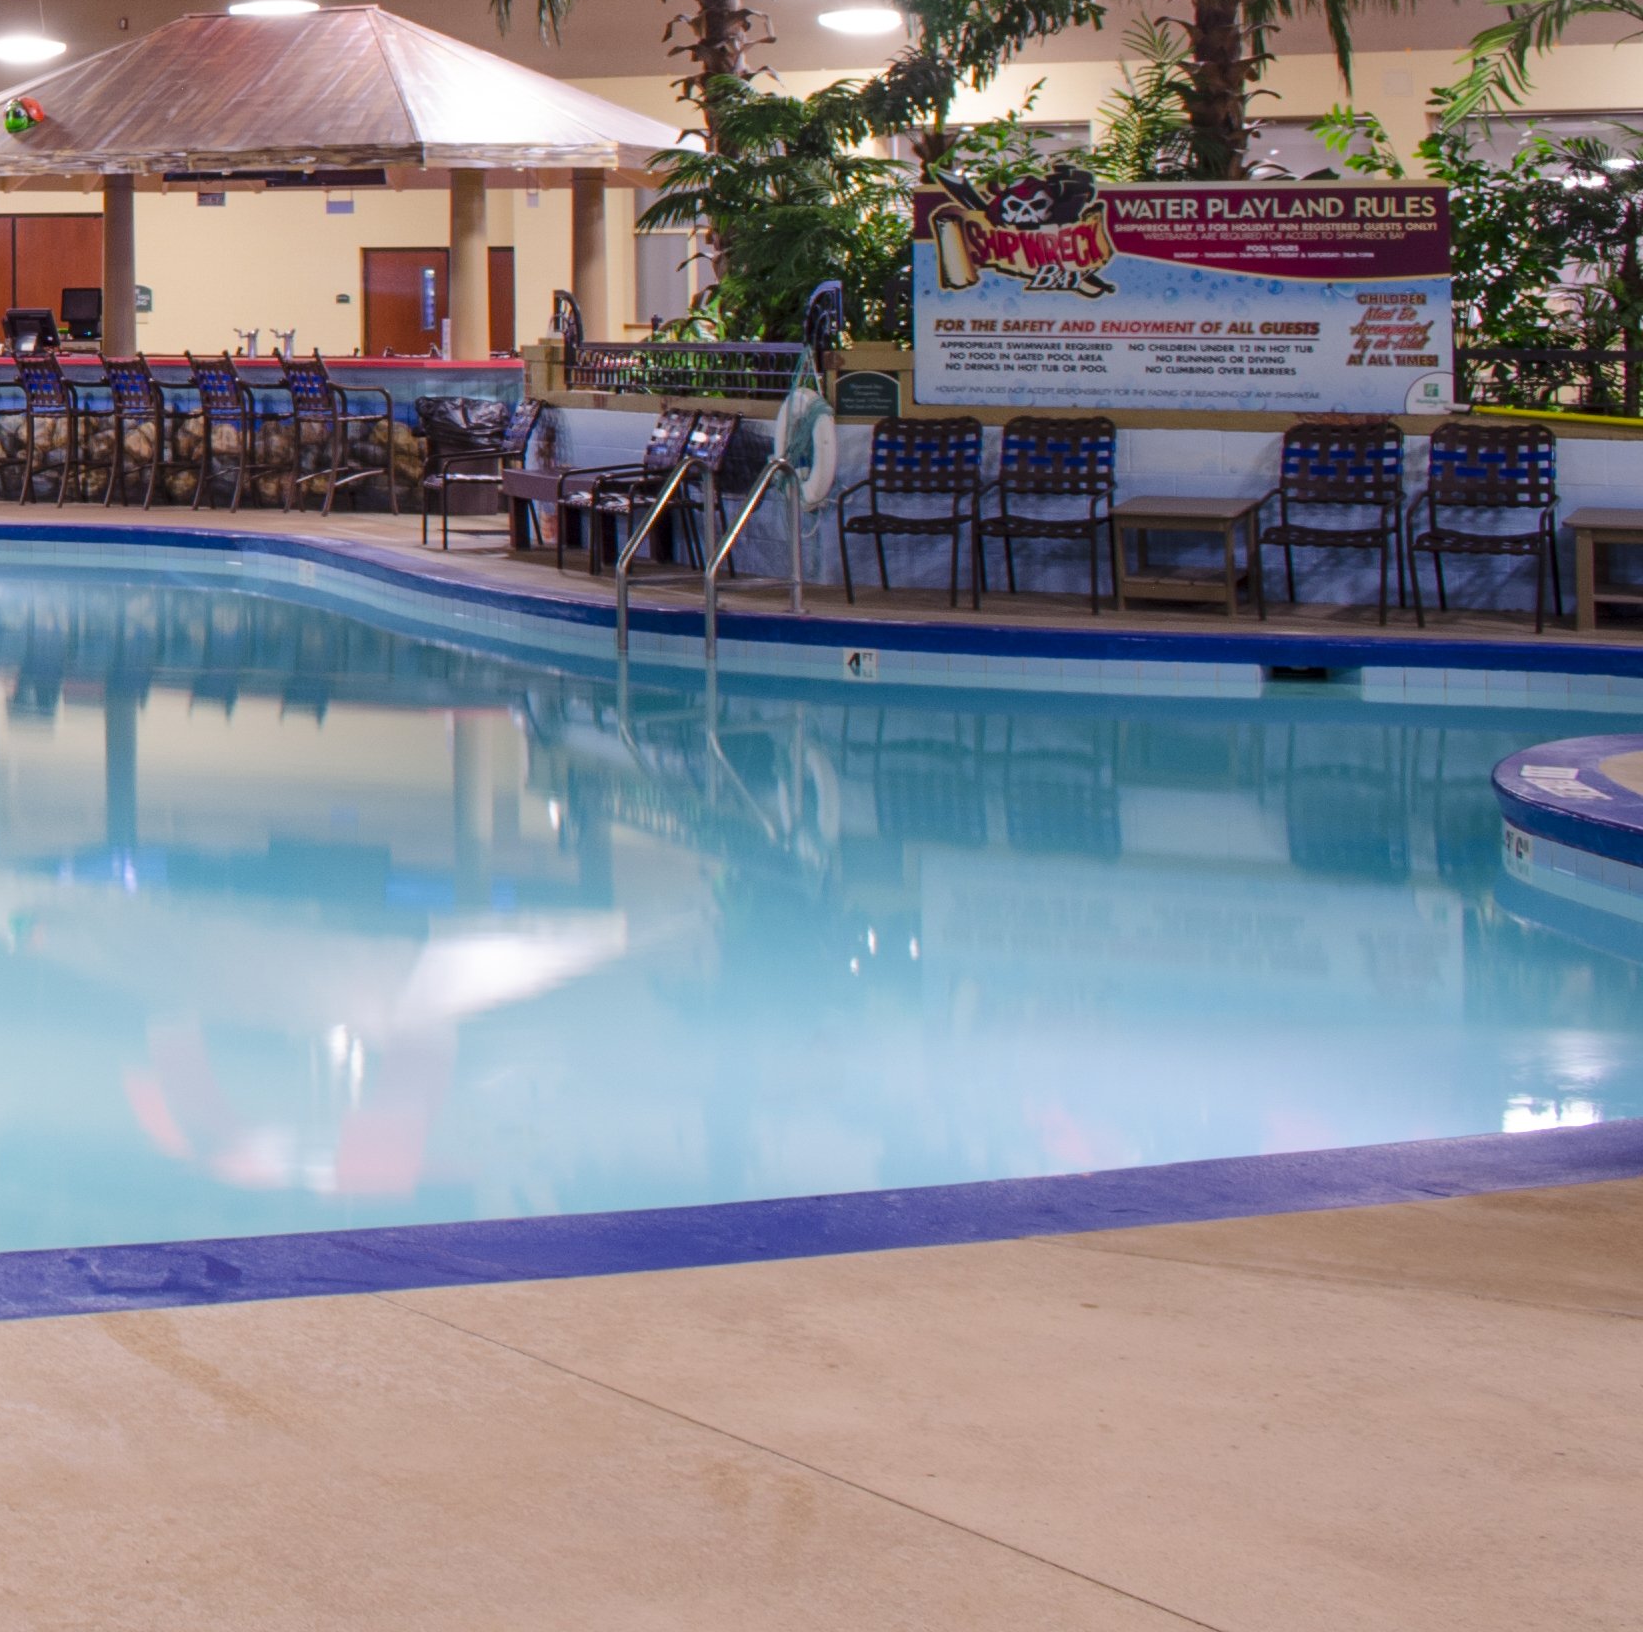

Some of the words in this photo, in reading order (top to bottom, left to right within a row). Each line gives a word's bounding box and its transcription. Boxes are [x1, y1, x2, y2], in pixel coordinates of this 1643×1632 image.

[1114, 198, 1198, 219] WATER
[1207, 197, 1345, 219] PLAYLAND
[1355, 196, 1437, 218] RULES
[1114, 224, 1170, 233] SHIPWRECK
[1174, 224, 1193, 232] BAY
[1196, 224, 1205, 232] IS
[1209, 224, 1228, 232] FOR
[1231, 223, 1275, 232] HOLIDAY
[1278, 223, 1299, 231] INN
[1302, 223, 1360, 231] REGISTERED
[1363, 222, 1402, 231] GUESTS
[1405, 222, 1438, 231] ONLY!
[1143, 232, 1198, 240] WRISTBANDS
[1201, 232, 1218, 240] ARE
[1220, 232, 1262, 240] REQUIRED
[1264, 232, 1282, 240] FOR
[1285, 232, 1319, 240] ACCESS
[1321, 232, 1334, 240] TO
[1336, 232, 1386, 240] SHIPWRECK
[1389, 232, 1407, 240] BAY
[966, 221, 1103, 270] SHIPWRECK
[1356, 293, 1427, 305] CHILDREN
[934, 319, 965, 332] FOR
[970, 319, 998, 332] THE
[1002, 320, 1057, 333] SAFETY
[1060, 320, 1095, 333] AND
[1101, 321, 1195, 334] ENJOYMENT
[1200, 322, 1223, 334] OF
[1227, 322, 1255, 334] ALL
[1259, 322, 1320, 335] GUESTS
[940, 341, 1003, 350] APPROPRIATE
[1006, 342, 1061, 350] SWIMWARE
[1065, 342, 1113, 351] REQUIRED
[1128, 343, 1145, 351] NO
[1148, 344, 1196, 352] CHILDREN
[1199, 344, 1235, 352] UNDER
[1239, 344, 1250, 352] 12
[1254, 344, 1266, 353] IN
[1269, 344, 1290, 353] HOT
[1294, 345, 1314, 353] TUB
[949, 352, 966, 360] NO
[969, 352, 996, 360] FOOD
[999, 352, 1010, 360] IN
[1013, 353, 1044, 361] GATED
[1047, 353, 1074, 361] POOL
[1077, 353, 1103, 361] AREA
[1155, 355, 1172, 363] NO
[1176, 355, 1226, 363] RUNNING
[1229, 355, 1244, 363] OR
[1247, 355, 1285, 364] DIVING
[1346, 354, 1364, 366] AT
[1367, 354, 1392, 366] ALL
[1394, 354, 1439, 367] TIMES!
[945, 362, 961, 371] NO
[964, 363, 1000, 371] DRINKS
[1003, 363, 1014, 371] IN
[1018, 363, 1038, 372] HOT
[1041, 364, 1059, 372] TUB
[1062, 364, 1077, 372] OR
[1080, 364, 1107, 373] POOL
[1145, 366, 1162, 374] NO
[1165, 366, 1214, 374] CLIMBING
[1217, 367, 1245, 375] OVER
[1249, 367, 1297, 376] BARRIERS
[1008, 386, 1025, 394] NOT
